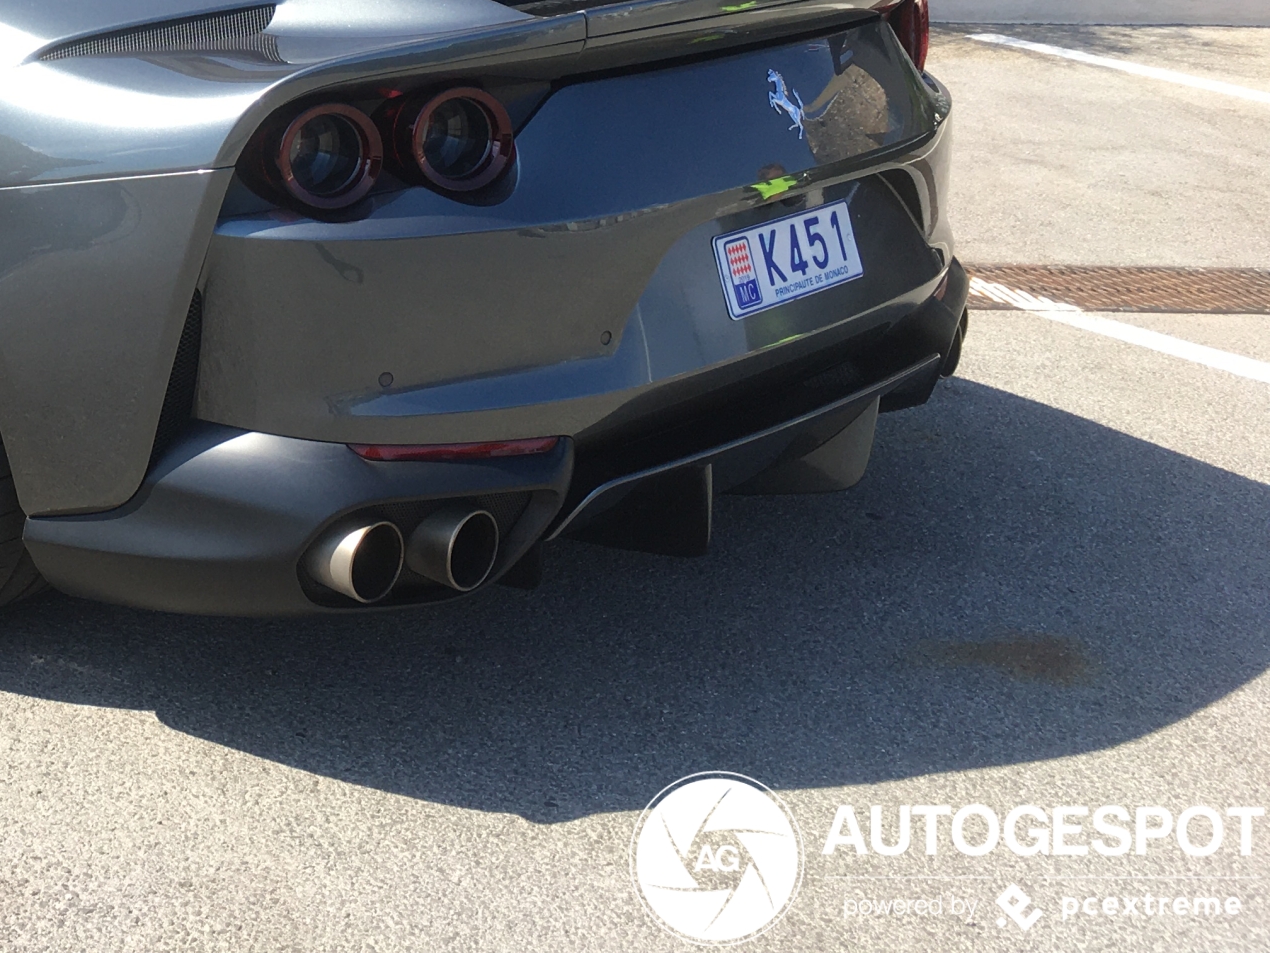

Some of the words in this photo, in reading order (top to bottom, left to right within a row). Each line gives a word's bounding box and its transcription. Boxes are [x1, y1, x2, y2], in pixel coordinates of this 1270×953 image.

[758, 211, 848, 287] K451
[739, 283, 757, 303] MC
[775, 277, 815, 298] PRINCIPAUTE
[815, 273, 824, 285] DE
[824, 265, 849, 281] MONACO
